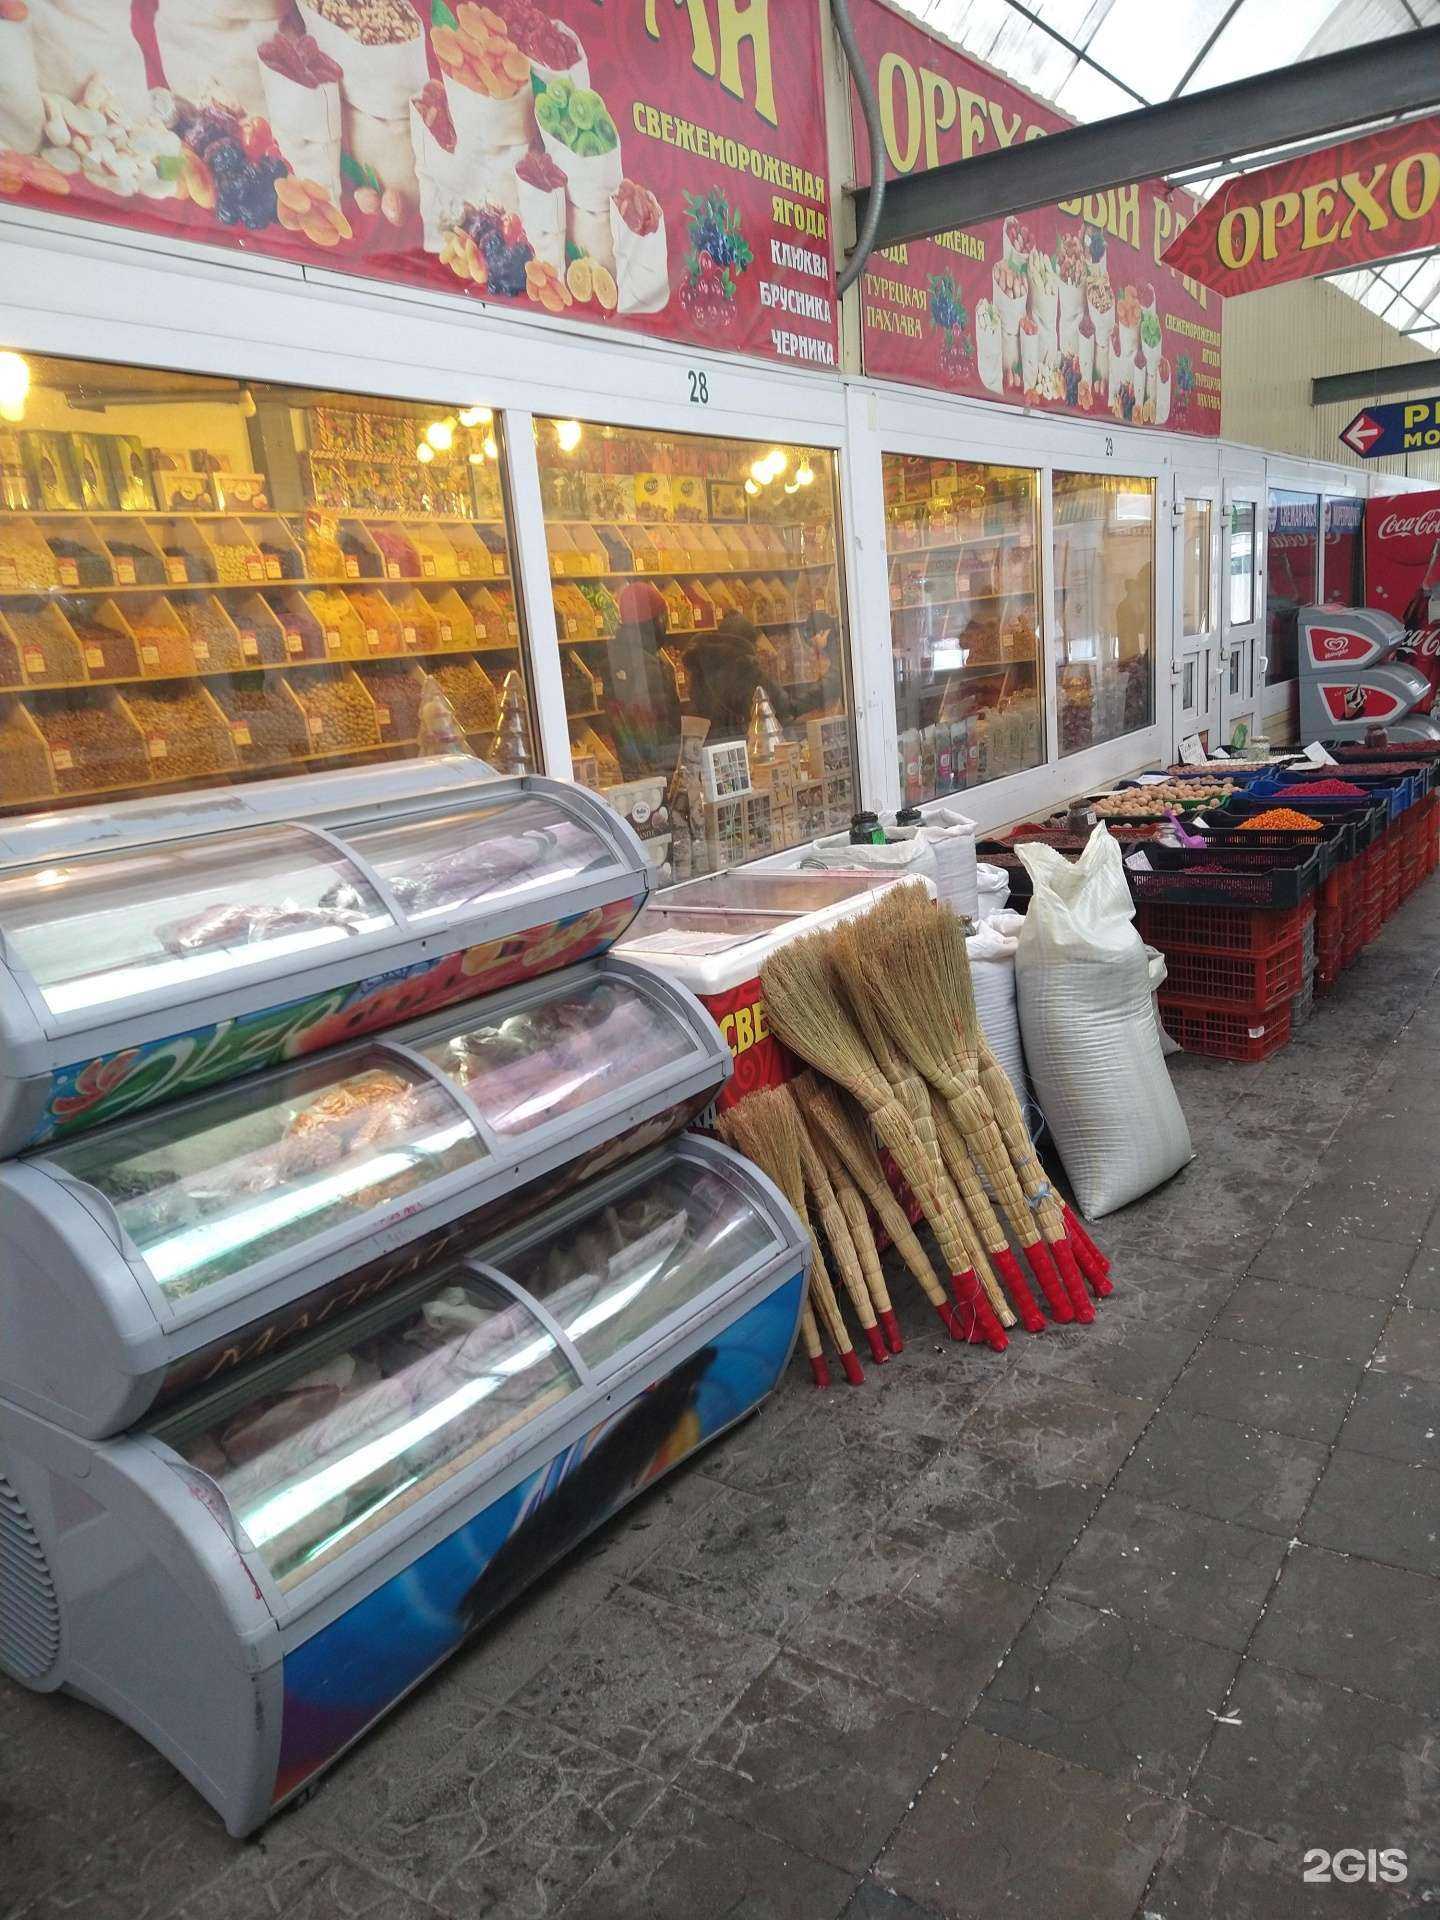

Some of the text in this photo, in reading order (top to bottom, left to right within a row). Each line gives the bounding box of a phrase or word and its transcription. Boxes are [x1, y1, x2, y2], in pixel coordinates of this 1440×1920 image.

[632, 101, 825, 204] СВЕЖЕМОРОЖЕНАЯ
[772, 195, 827, 240] ЯГОДА
[1218, 152, 1440, 270] ОРЕХО
[770, 239, 829, 281] КЛЮКВА
[759, 281, 832, 324] БРУСНИКА
[865, 273, 927, 311] ТУРЕЦКАЯ
[867, 305, 923, 339] ПАХЛАВА
[771, 328, 835, 366] ЧЕРНИКА
[687, 370, 709, 404] 28
[1105, 436, 1113, 457] 29
